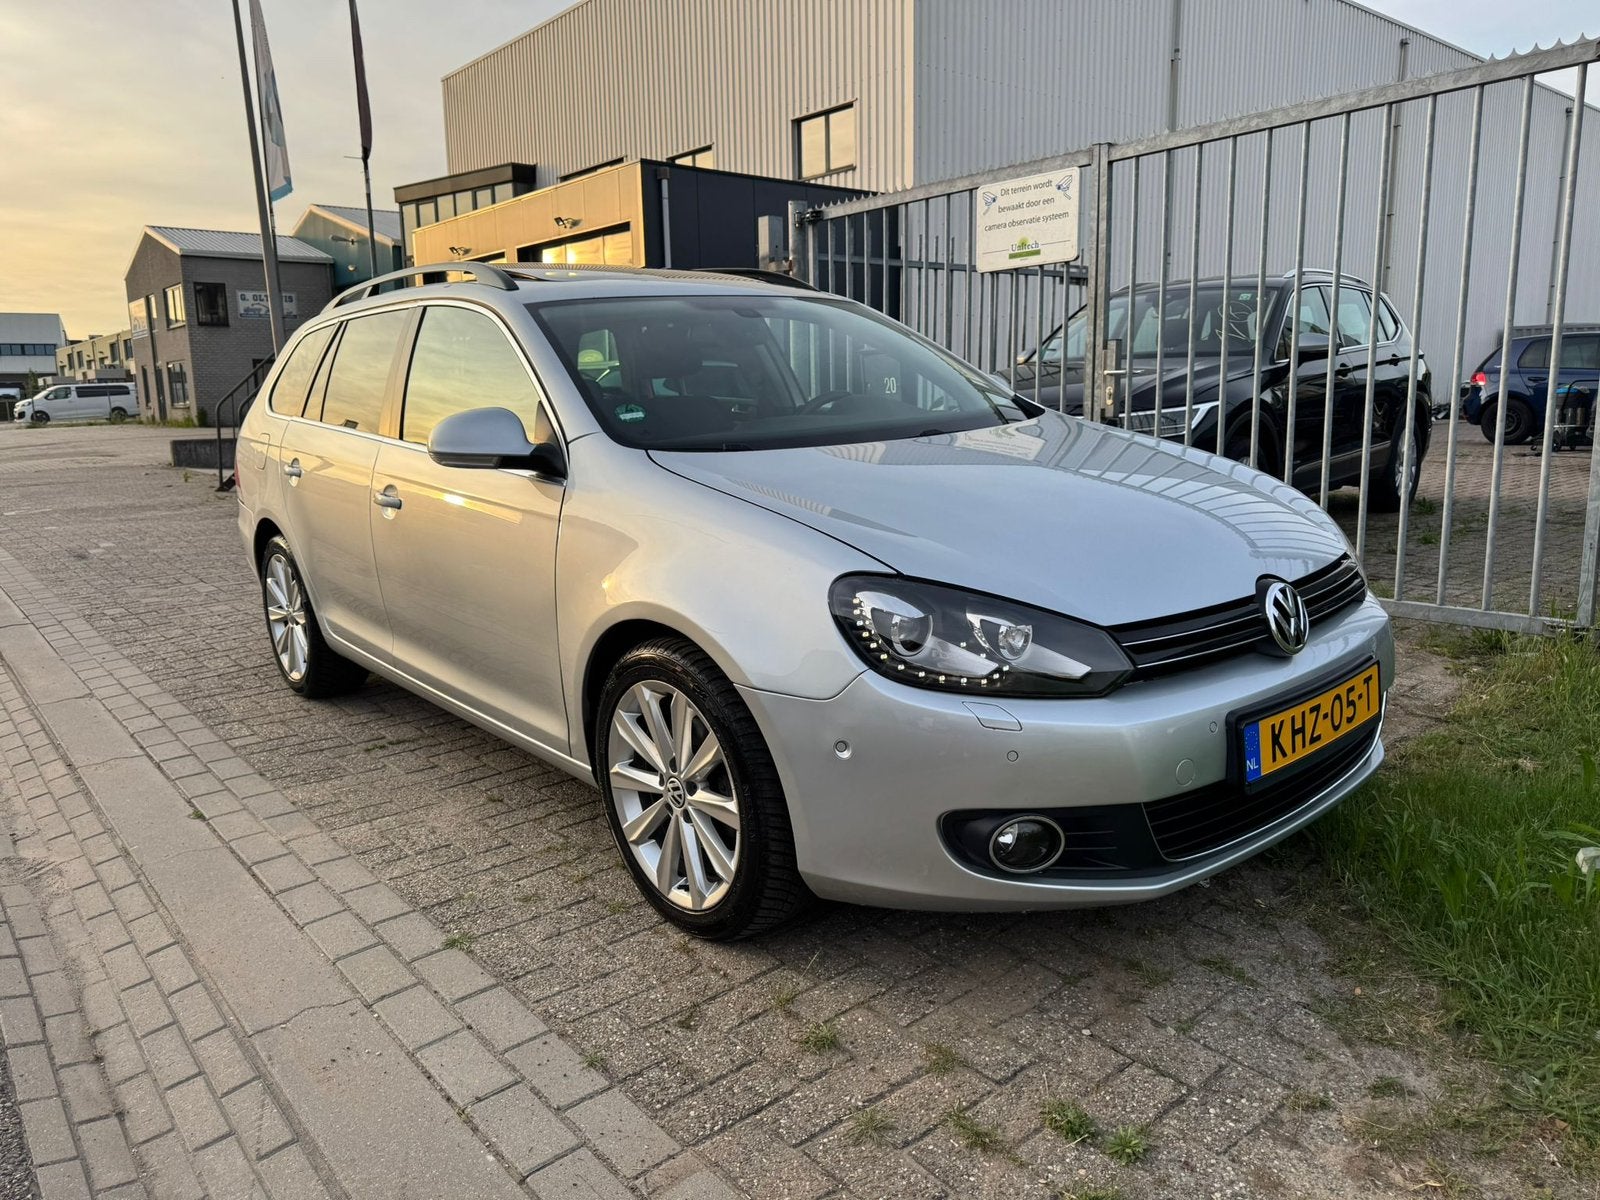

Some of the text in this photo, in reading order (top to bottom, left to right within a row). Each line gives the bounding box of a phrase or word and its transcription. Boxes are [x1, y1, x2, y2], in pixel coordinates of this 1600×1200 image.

[1000, 179, 1053, 197] Dit terrein wordt
[998, 197, 1055, 213] bewaakt door een
[984, 211, 1070, 232] camera observatie systeem
[884, 377, 897, 394] 20
[1270, 673, 1373, 763] KHZ-05-T
[1246, 757, 1259, 772] NL
